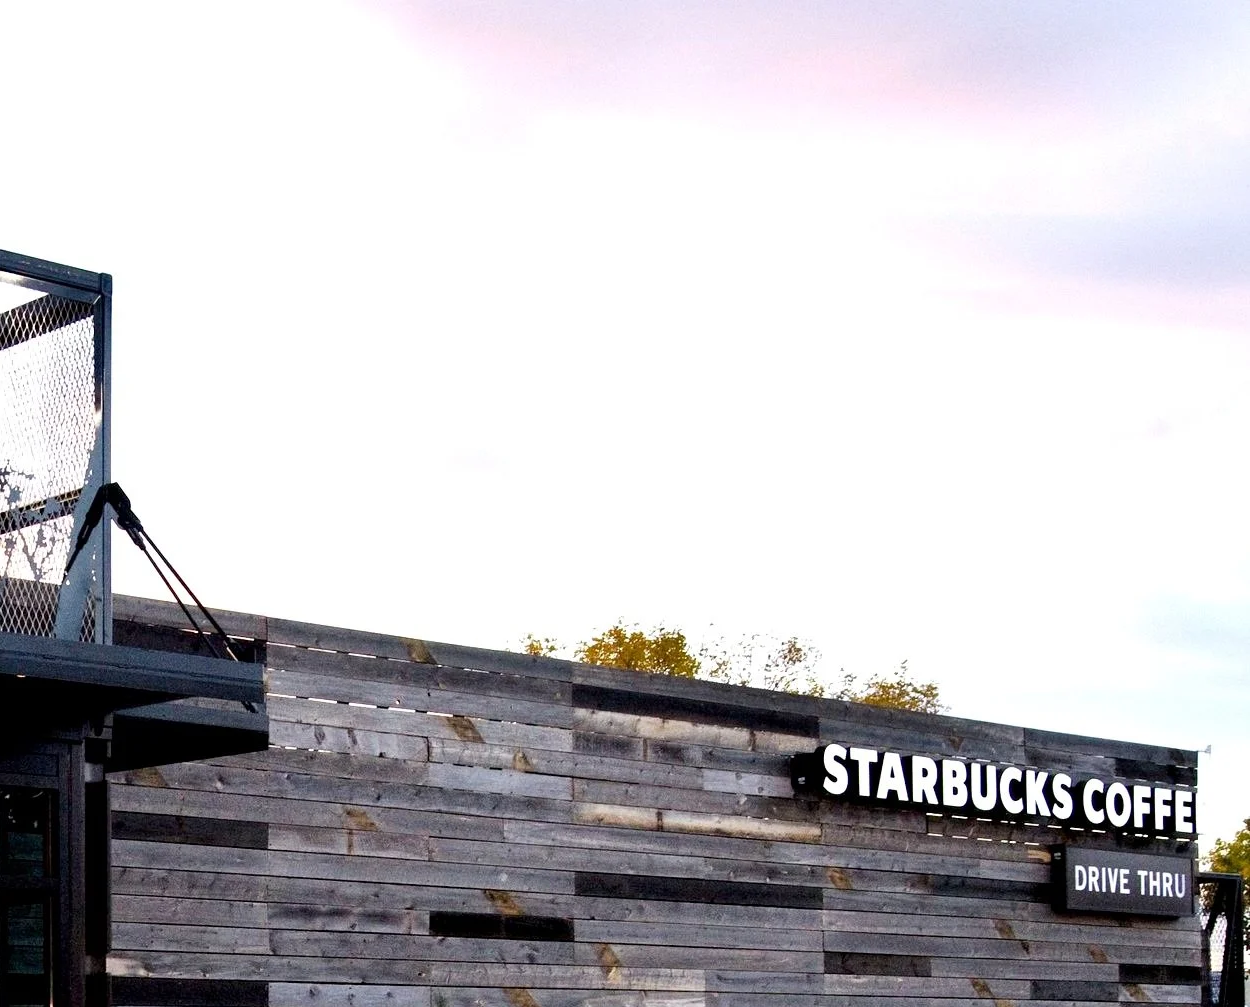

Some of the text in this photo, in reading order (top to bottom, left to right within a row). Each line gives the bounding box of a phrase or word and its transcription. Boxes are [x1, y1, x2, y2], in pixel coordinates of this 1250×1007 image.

[823, 743, 1074, 820] STARBUCKS
[1074, 864, 1186, 899] DRIVE THRU
